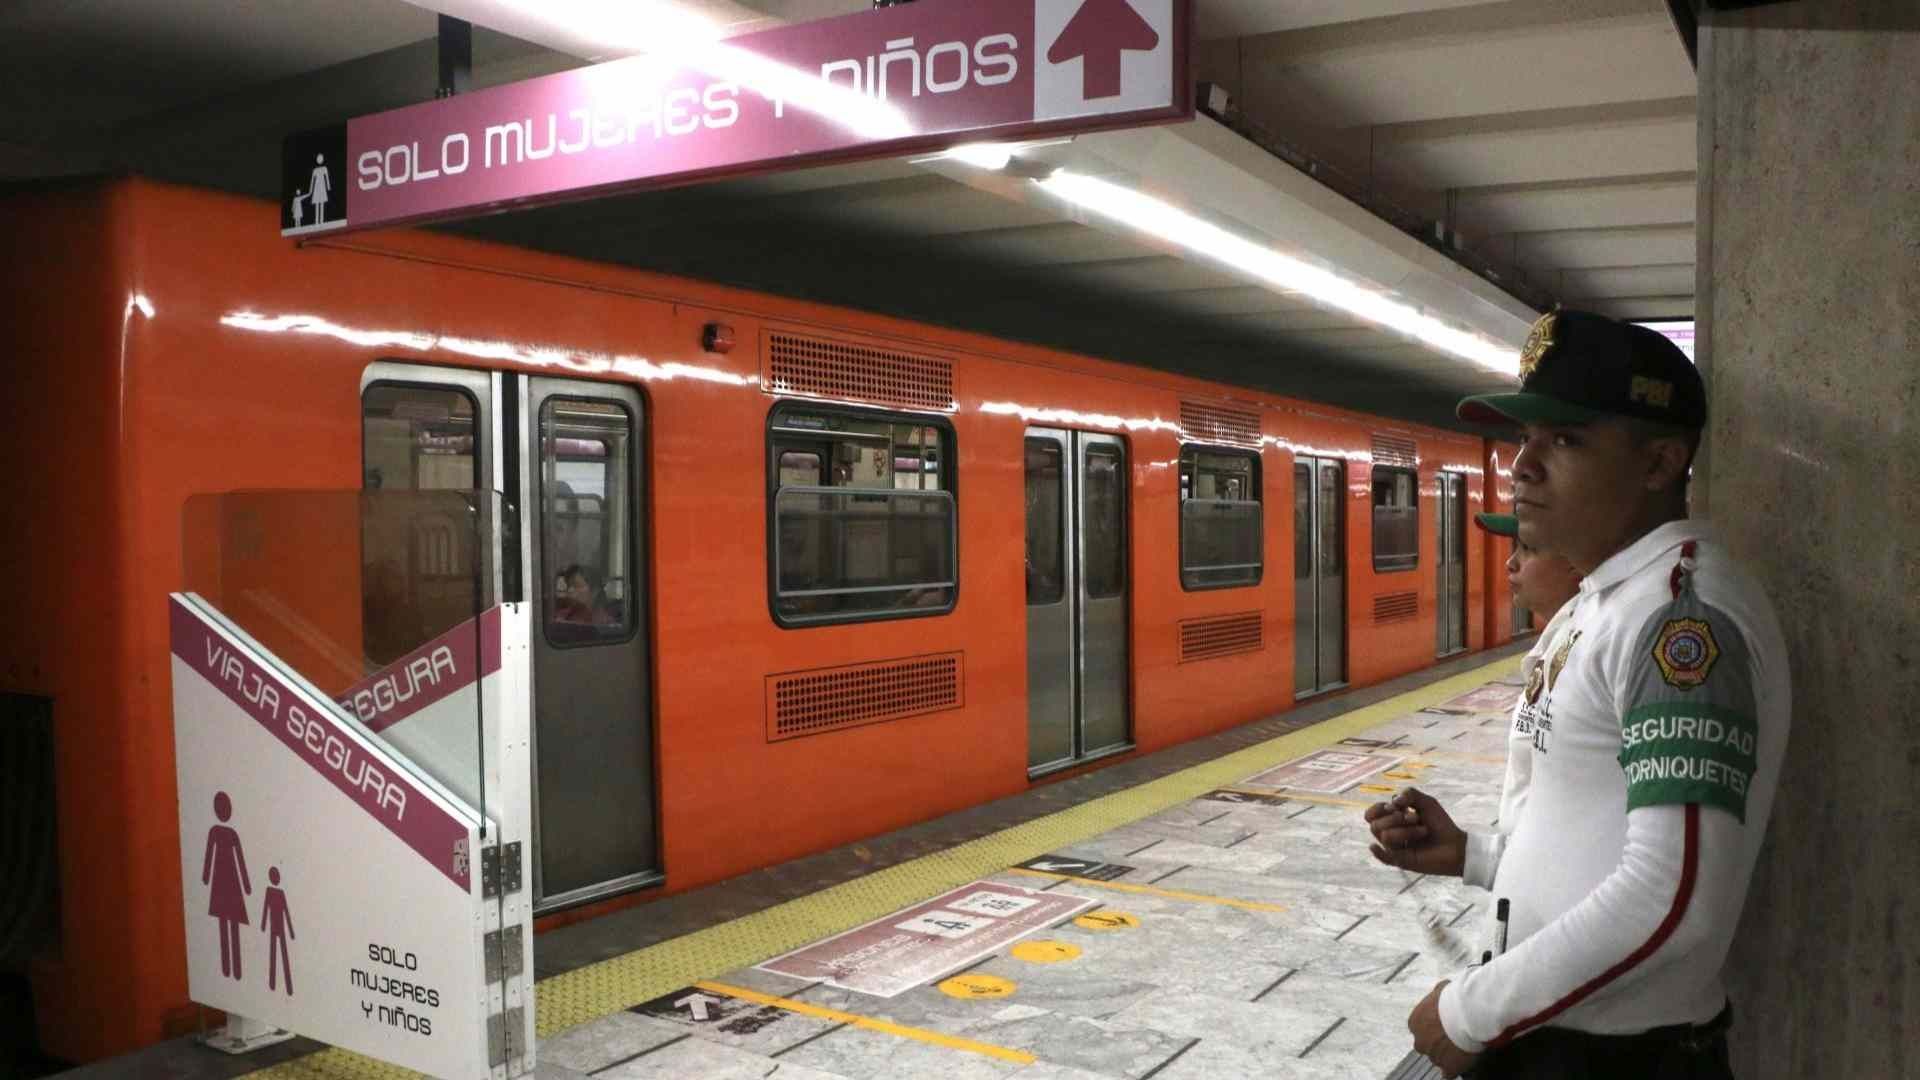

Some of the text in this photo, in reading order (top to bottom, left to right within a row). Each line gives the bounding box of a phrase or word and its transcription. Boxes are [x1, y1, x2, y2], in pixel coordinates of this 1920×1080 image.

[358, 133, 469, 191] SOLO
[821, 33, 1018, 98] NIÑOS
[206, 636, 407, 821] VIAJA SEGURA
[1621, 716, 1753, 756] SEGURIDAD
[368, 943, 418, 972] SOLO
[350, 968, 440, 1008] MUJERES
[360, 1000, 433, 1036] Y NIÑOS
